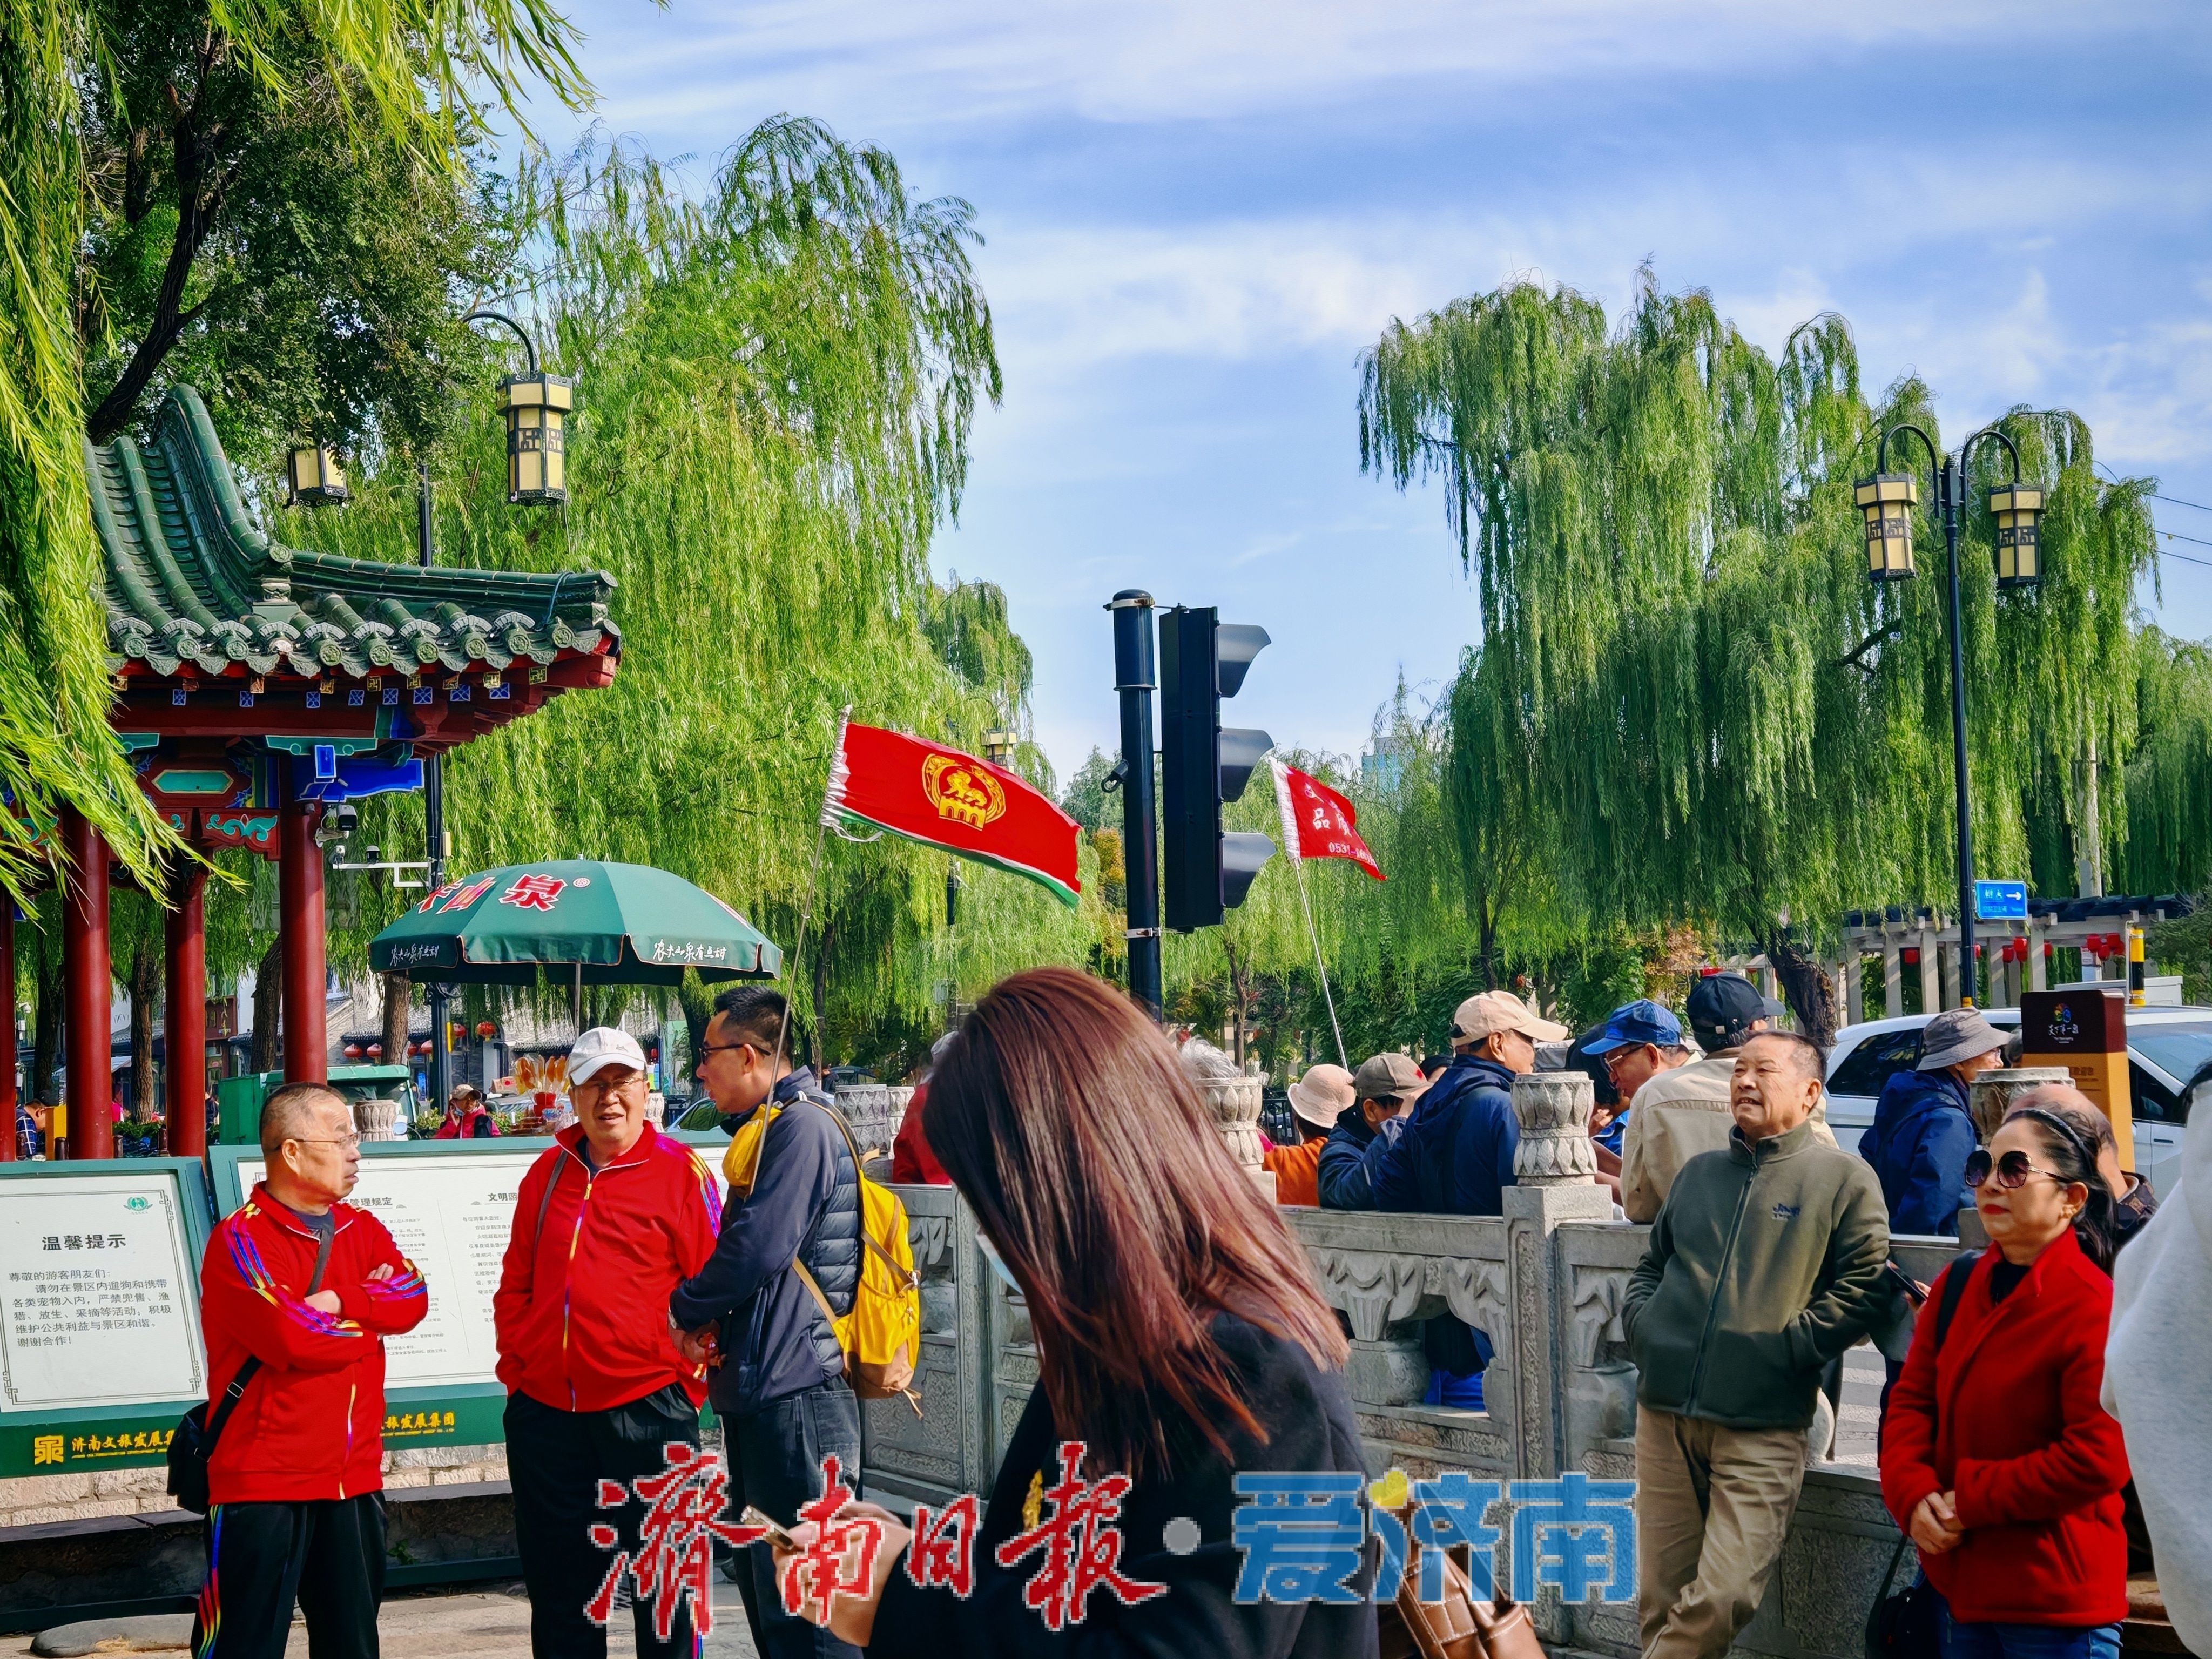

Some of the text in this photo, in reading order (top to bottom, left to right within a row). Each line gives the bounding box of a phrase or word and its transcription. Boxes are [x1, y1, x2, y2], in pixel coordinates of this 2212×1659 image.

[652, 939, 727, 963] 农夫山泉有点甜
[42, 1233, 126, 1251] 温馨提示
[35, 1279, 167, 1294] 请勿在景区内遛狗和携带
[381, 1412, 455, 1430] 旅发展集团
